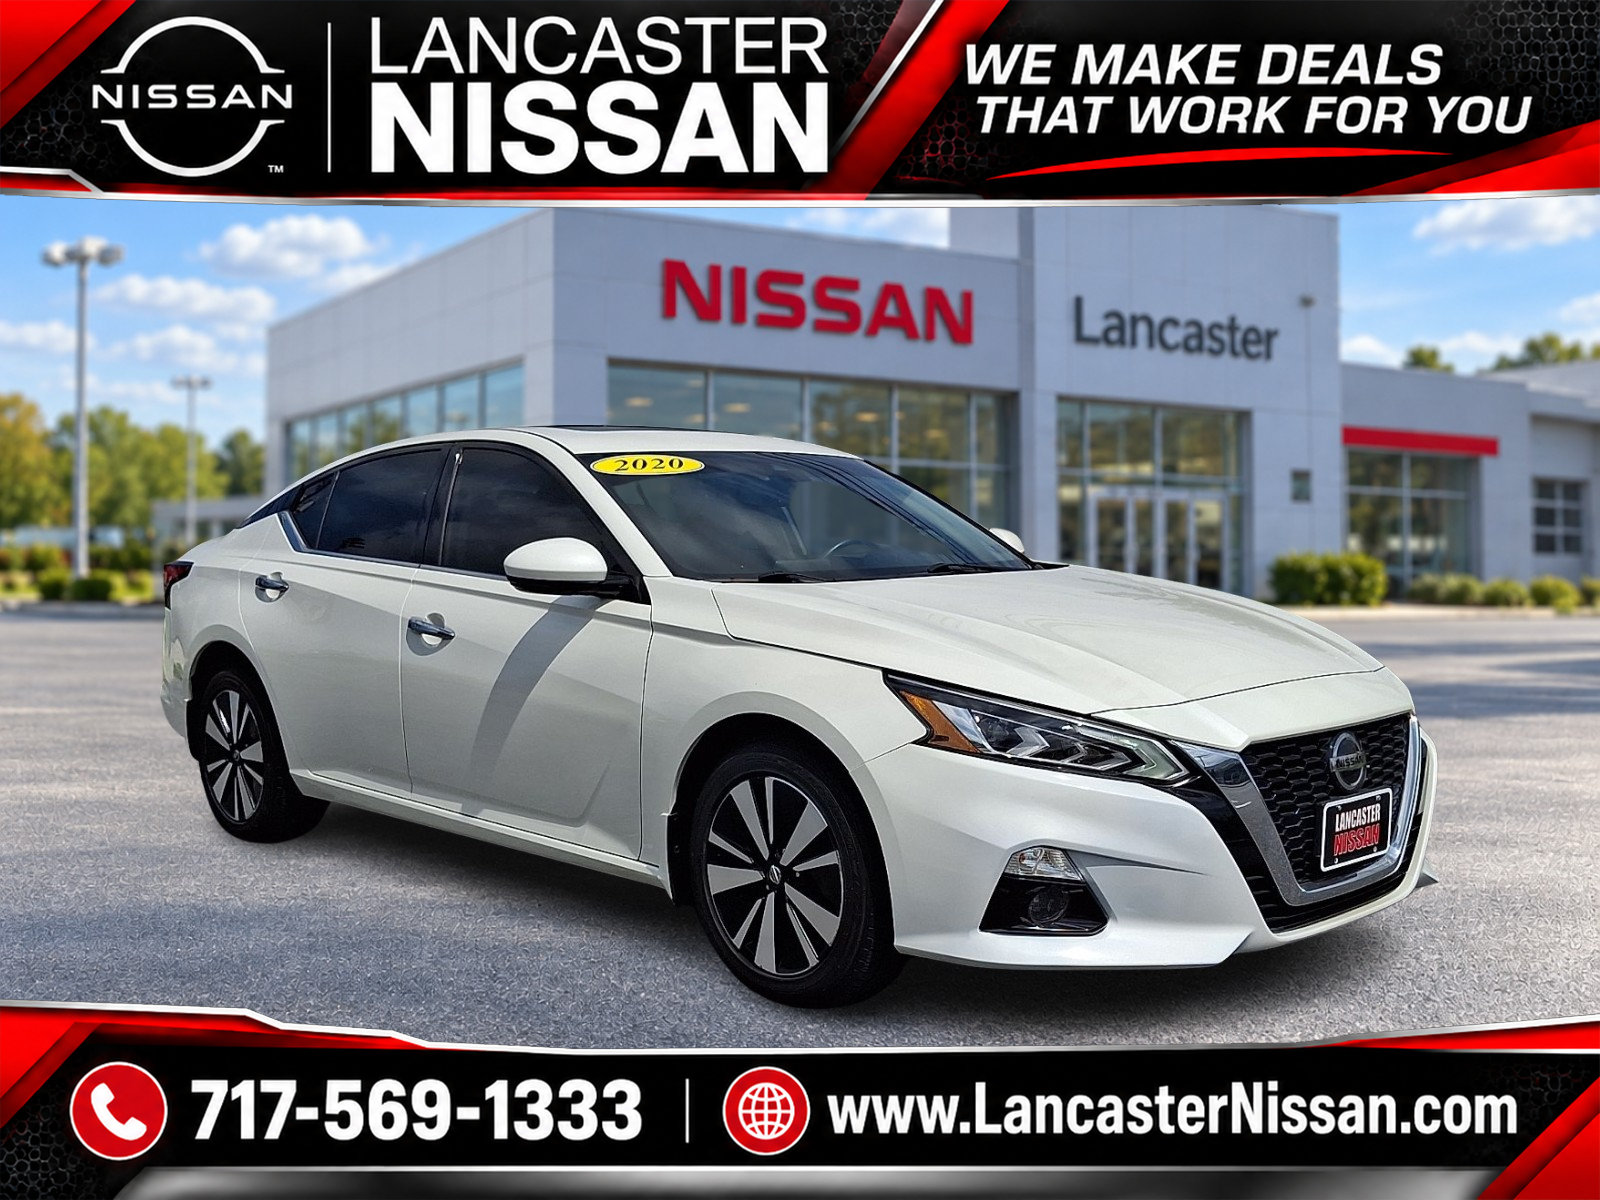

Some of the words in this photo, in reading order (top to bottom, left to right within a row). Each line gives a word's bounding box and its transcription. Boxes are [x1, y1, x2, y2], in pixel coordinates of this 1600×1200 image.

[661, 258, 974, 346] NISSAN
[1073, 295, 1279, 361] Lancaster
[614, 458, 684, 472] 2020
[1335, 803, 1380, 832] LANCASTER
[1333, 823, 1380, 856] NISSAN
